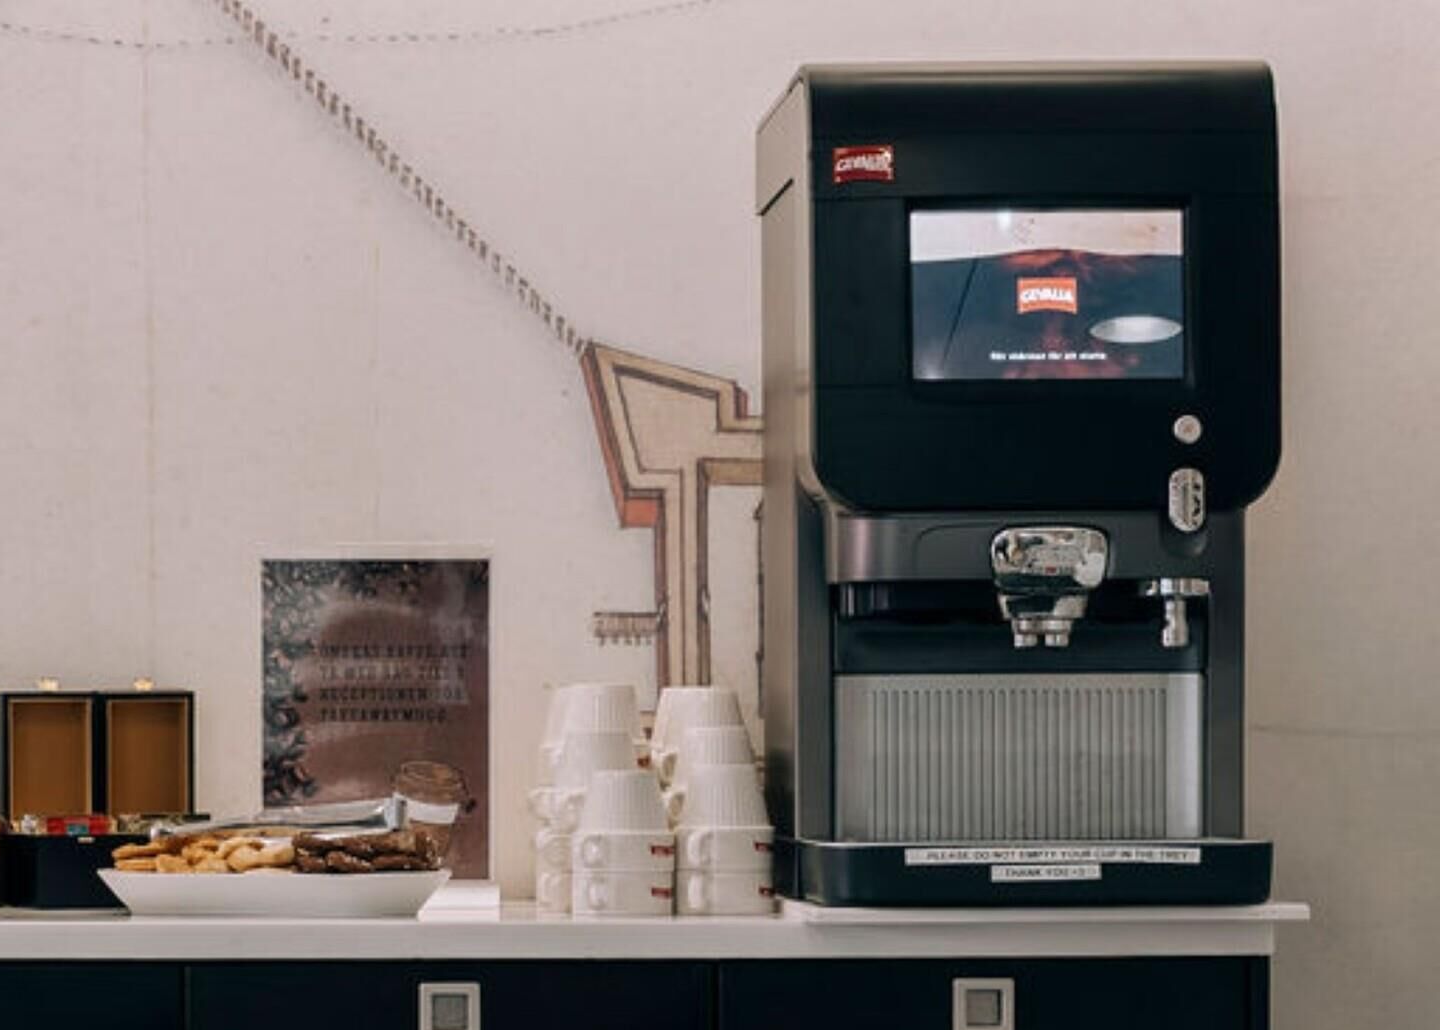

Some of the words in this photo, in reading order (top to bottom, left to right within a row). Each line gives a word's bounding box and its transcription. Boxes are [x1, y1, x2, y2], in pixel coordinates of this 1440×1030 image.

[836, 152, 891, 171] GEVALIA
[1019, 287, 1073, 304] GEVALIA
[927, 851, 968, 860] PLEASE
[973, 851, 989, 860] DO
[992, 850, 1016, 859] NOT
[1019, 850, 1056, 859] EMPTY
[1061, 850, 1091, 859] YOUR
[1095, 850, 1116, 859] CUP
[1006, 868, 1040, 878] THANK
[1045, 868, 1067, 877] YOU
